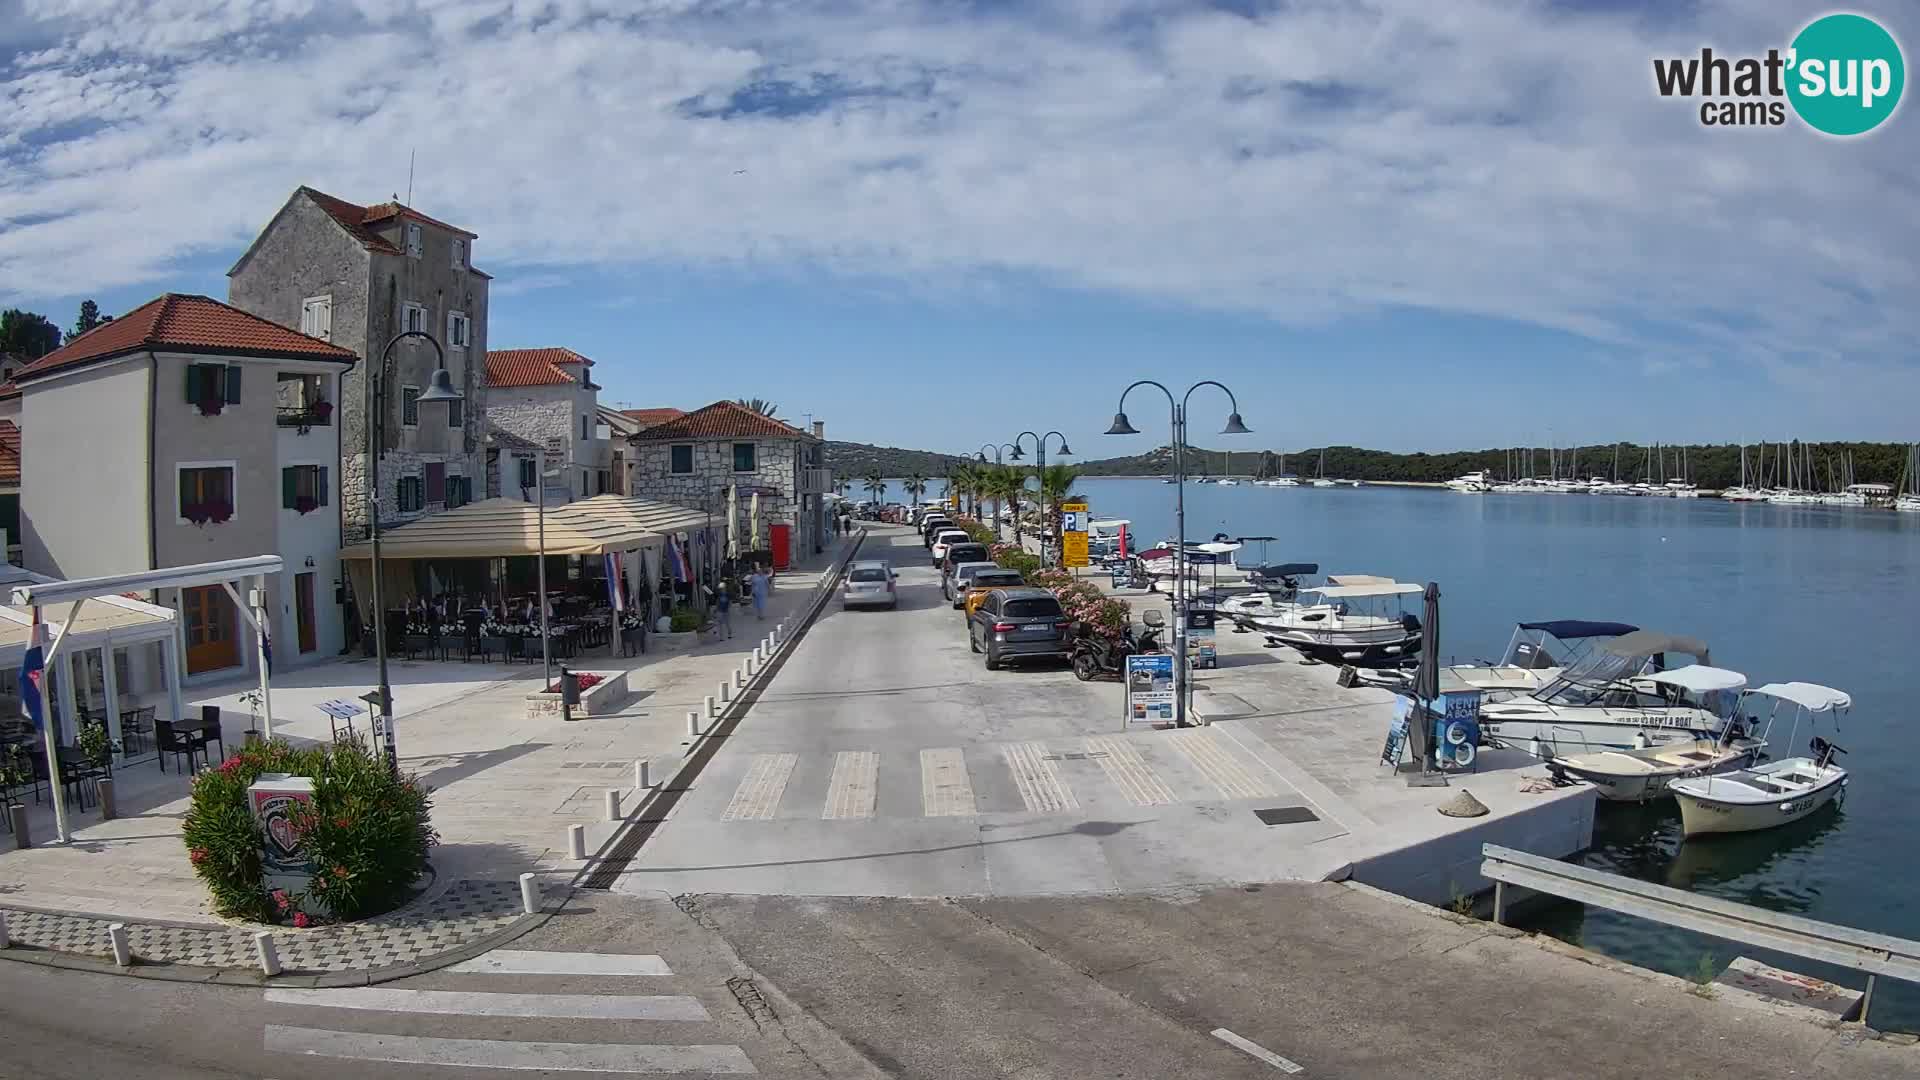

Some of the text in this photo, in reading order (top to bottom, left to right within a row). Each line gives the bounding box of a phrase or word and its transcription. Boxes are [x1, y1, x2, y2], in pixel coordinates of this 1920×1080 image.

[1065, 513, 1075, 530] P
[1447, 696, 1478, 710] RENT
[1446, 709, 1478, 719] A BOAT
[1675, 716, 1693, 728] BOAT
